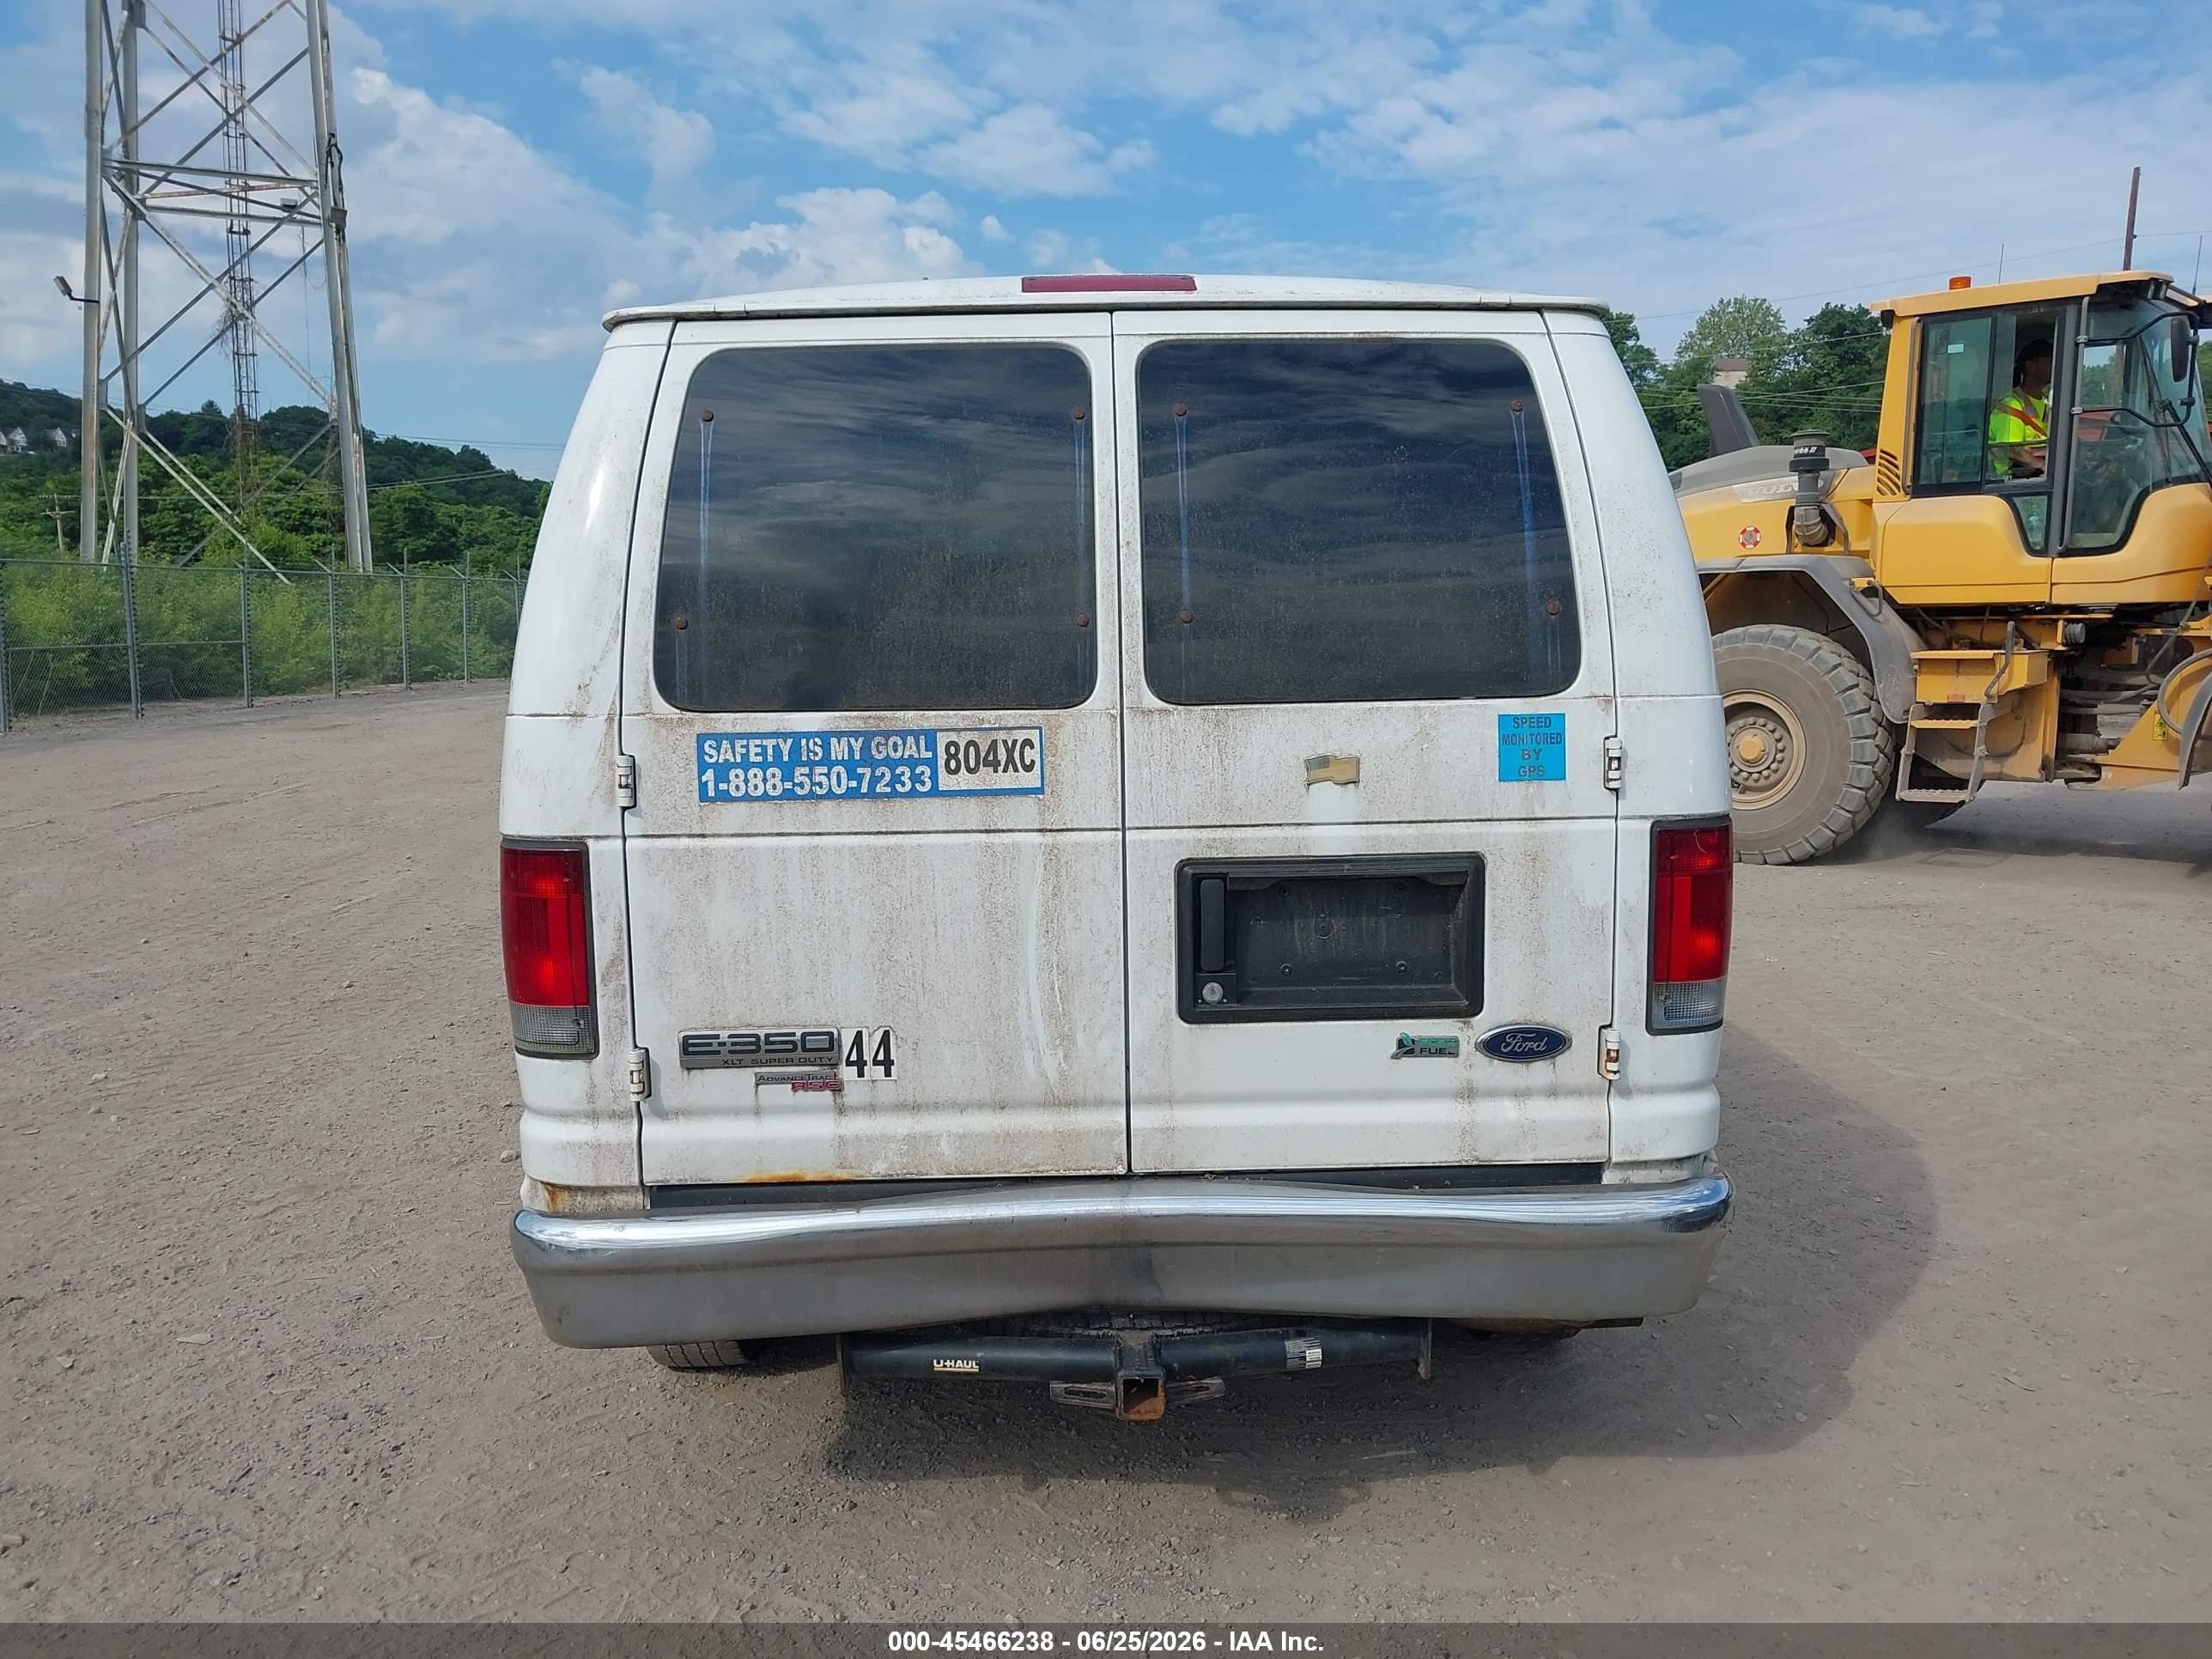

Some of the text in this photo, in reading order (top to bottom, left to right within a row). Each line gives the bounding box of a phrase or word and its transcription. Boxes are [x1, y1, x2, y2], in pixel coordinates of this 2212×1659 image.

[1513, 717, 1551, 728] SPEED
[703, 734, 933, 763] SAFETY IS MY GOAL
[1503, 732, 1562, 745] MONITORED
[944, 738, 1036, 775] 804XC
[1522, 749, 1542, 760] BY
[701, 765, 933, 798] 1-888-550-7233
[1518, 766, 1546, 777] GPS
[682, 1031, 836, 1056] E-350
[1500, 1032, 1549, 1053] Ford
[845, 1030, 896, 1079] 44
[933, 1359, 979, 1368] U-HAUL
